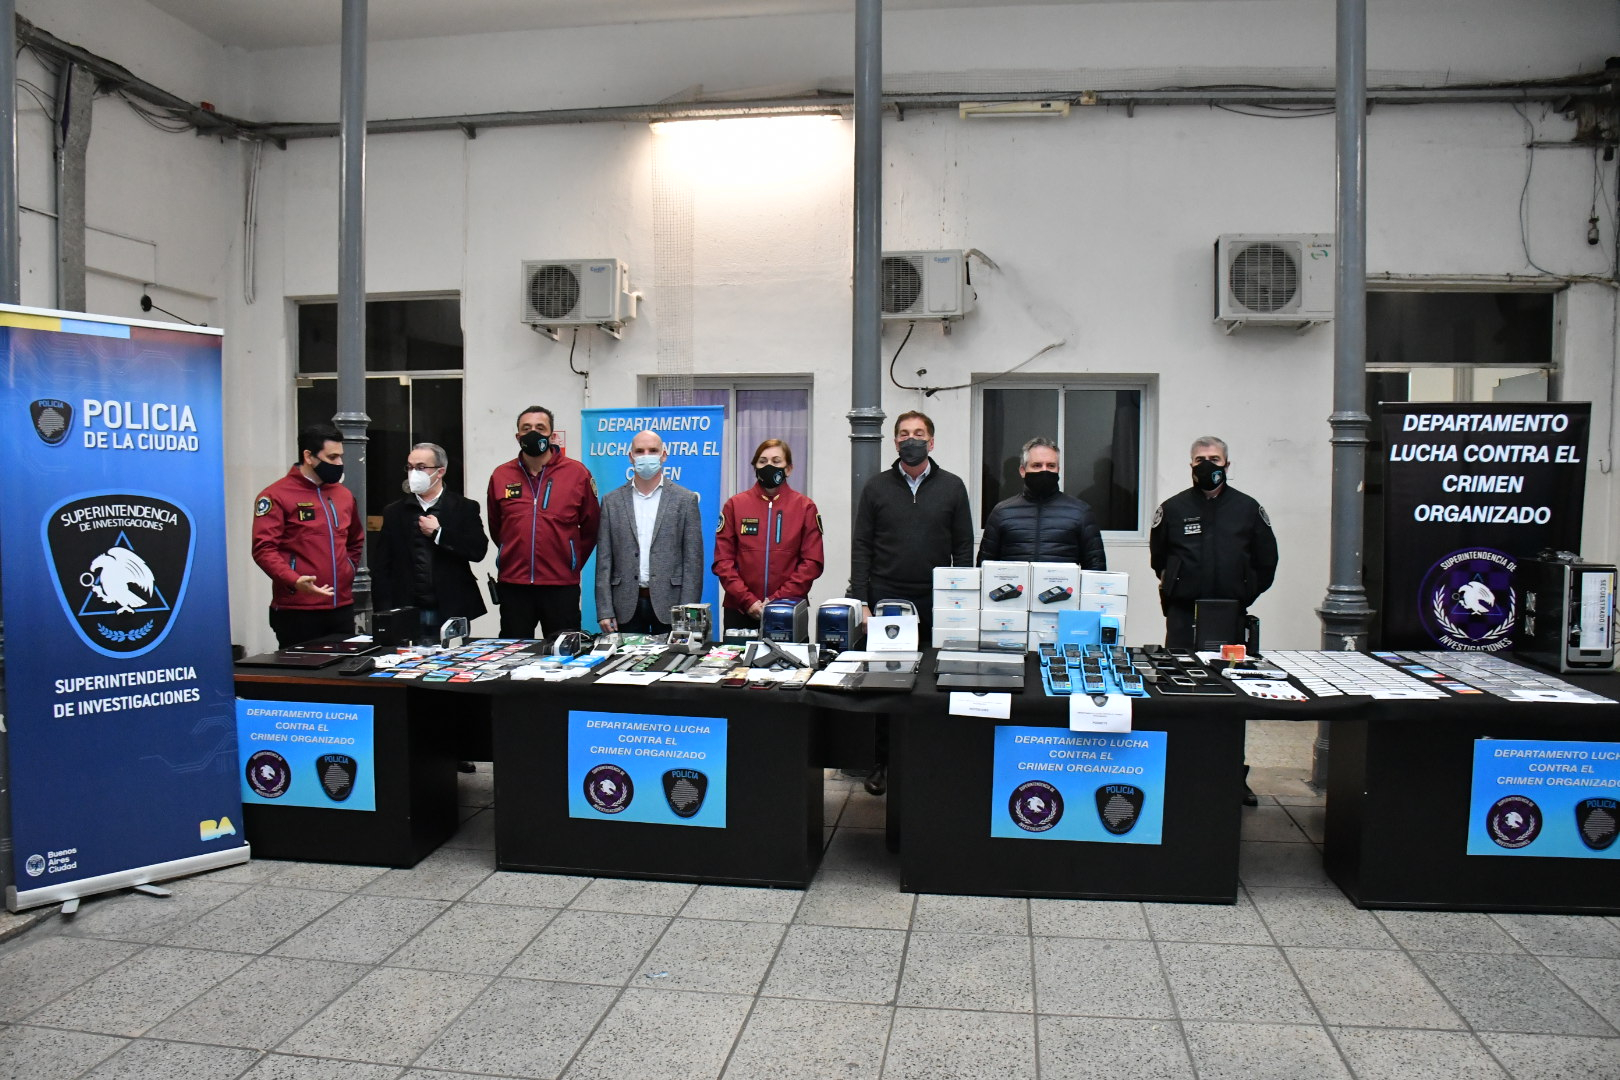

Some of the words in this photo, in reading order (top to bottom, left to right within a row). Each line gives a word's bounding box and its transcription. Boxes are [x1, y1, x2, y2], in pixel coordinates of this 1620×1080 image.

[83, 399, 197, 432] POLICIA
[598, 416, 710, 432] DEPARTAMENTO
[1402, 414, 1568, 433] DEPARTAMENTO
[84, 431, 108, 448] DE
[112, 434, 134, 449] LA
[138, 434, 199, 451] CIUDAD
[662, 441, 698, 456] NTRA
[702, 441, 720, 456] EL
[1390, 444, 1458, 462] LUCHA
[1463, 444, 1549, 463] CONTRA
[1555, 445, 1580, 463] EL
[625, 466, 682, 480] CEN
[1442, 475, 1524, 493] CRIMEN
[60, 504, 178, 526] SUPERINTENDENCIA
[1414, 505, 1551, 524] ORGANIZADO
[78, 522, 92, 532] DE
[93, 518, 164, 531] INVESTIGACIONES
[1440, 551, 1508, 570] SUPERINTENDENCIA
[1506, 562, 1517, 572] DE
[1439, 635, 1512, 652] INVESTIGACIONES
[55, 666, 197, 694] SUPERINTENDENCIA
[54, 703, 75, 718] DE
[78, 688, 200, 715] INVESTIGACIONES
[246, 708, 323, 719] DEPARTAMENTO
[326, 712, 358, 720] LUCHA
[276, 722, 315, 731] CONTRA
[586, 720, 672, 732] DEPARTAMENTO
[674, 725, 711, 734] LUCHA
[250, 733, 288, 742] CRIMEN
[290, 735, 355, 745] ORGANIZADO
[618, 734, 662, 744] CONTRA
[665, 738, 677, 746] EL
[1014, 735, 1106, 747] DEPARTAMENTO
[1110, 738, 1149, 748] LUCHA
[590, 746, 632, 755] CRIMEN
[635, 748, 707, 760] ORGANIZADO
[1049, 750, 1097, 760] CONTRA
[1100, 752, 1113, 760] EL
[1494, 749, 1588, 760] DEPARTAMENTO
[672, 770, 699, 779] POLICIA
[1018, 762, 1063, 772] CRIMEN
[1066, 764, 1144, 775] ORGANIZADO
[1528, 764, 1577, 772] CONTRA
[1581, 765, 1595, 773] EL
[1497, 776, 1543, 785] CRIMEN
[1106, 786, 1135, 795] POLICIA
[48, 848, 77, 858] Buenos
[48, 857, 70, 866] Aires
[49, 861, 77, 873] Ciudad
